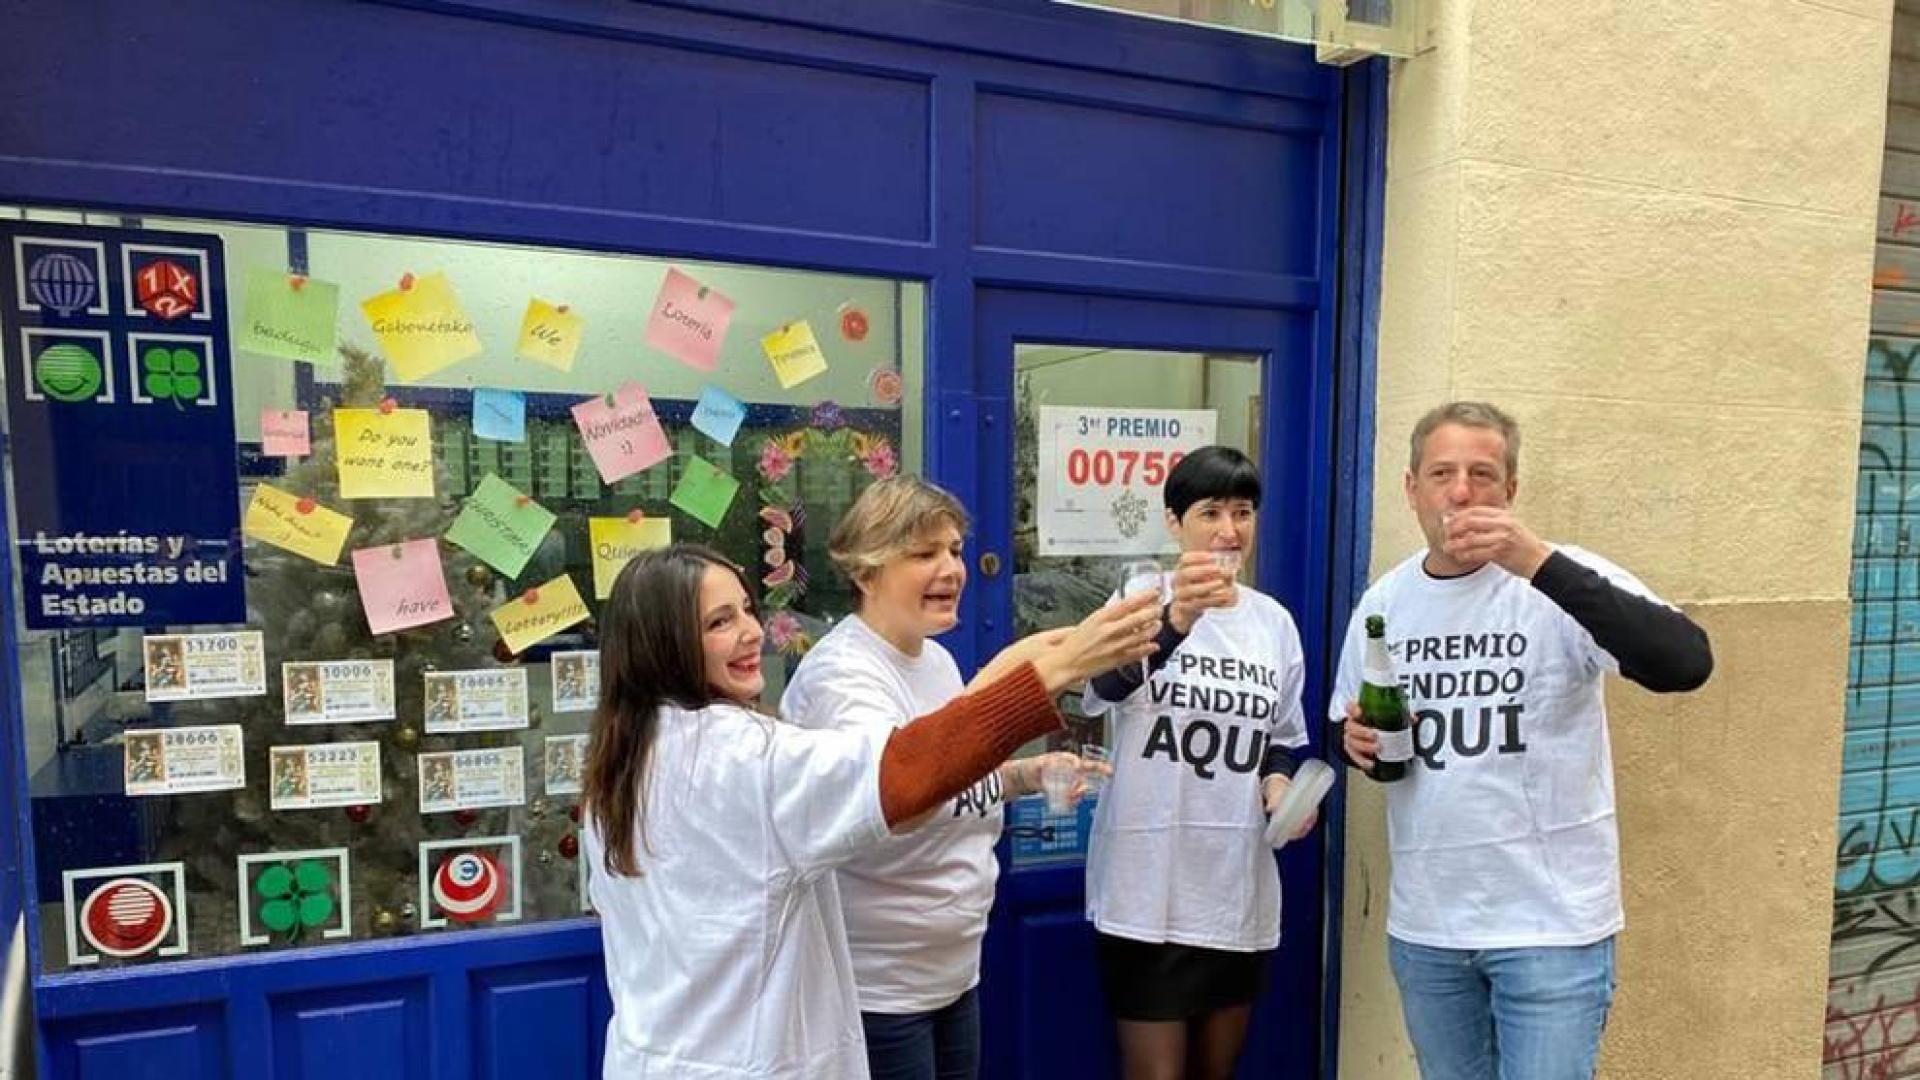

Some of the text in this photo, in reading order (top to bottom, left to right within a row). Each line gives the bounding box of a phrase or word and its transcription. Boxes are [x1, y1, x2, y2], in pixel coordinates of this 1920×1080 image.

[385, 434, 418, 449] you
[1106, 416, 1182, 439] PREMIO
[167, 535, 184, 560] y
[41, 559, 228, 591] Apuestas del
[41, 590, 145, 617] Estado
[1405, 631, 1528, 664] PREMIO
[1398, 665, 1526, 699] ENDIDO
[1412, 697, 1528, 771] QUÍ
[953, 769, 1005, 818] AQU
